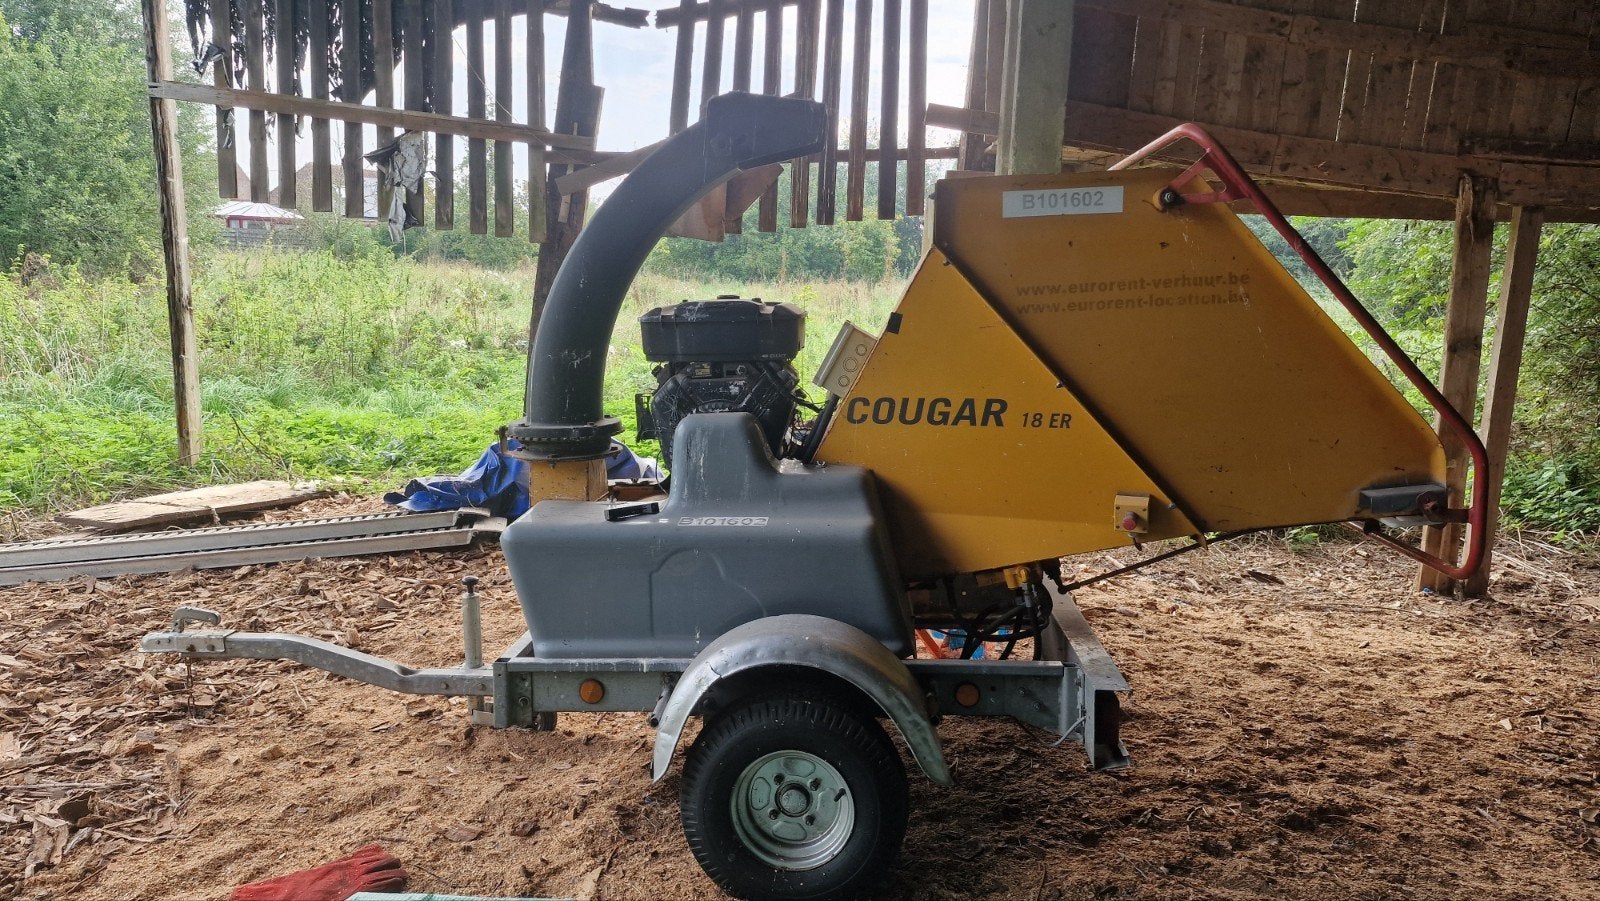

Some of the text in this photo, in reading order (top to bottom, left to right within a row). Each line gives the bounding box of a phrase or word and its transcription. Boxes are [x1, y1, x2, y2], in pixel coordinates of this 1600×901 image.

[1022, 191, 1104, 210] B101602
[1017, 271, 1250, 297] www.eurorent-verhuur.be
[846, 396, 1072, 429] COUGAR 18 ER
[678, 517, 767, 526] B101602
